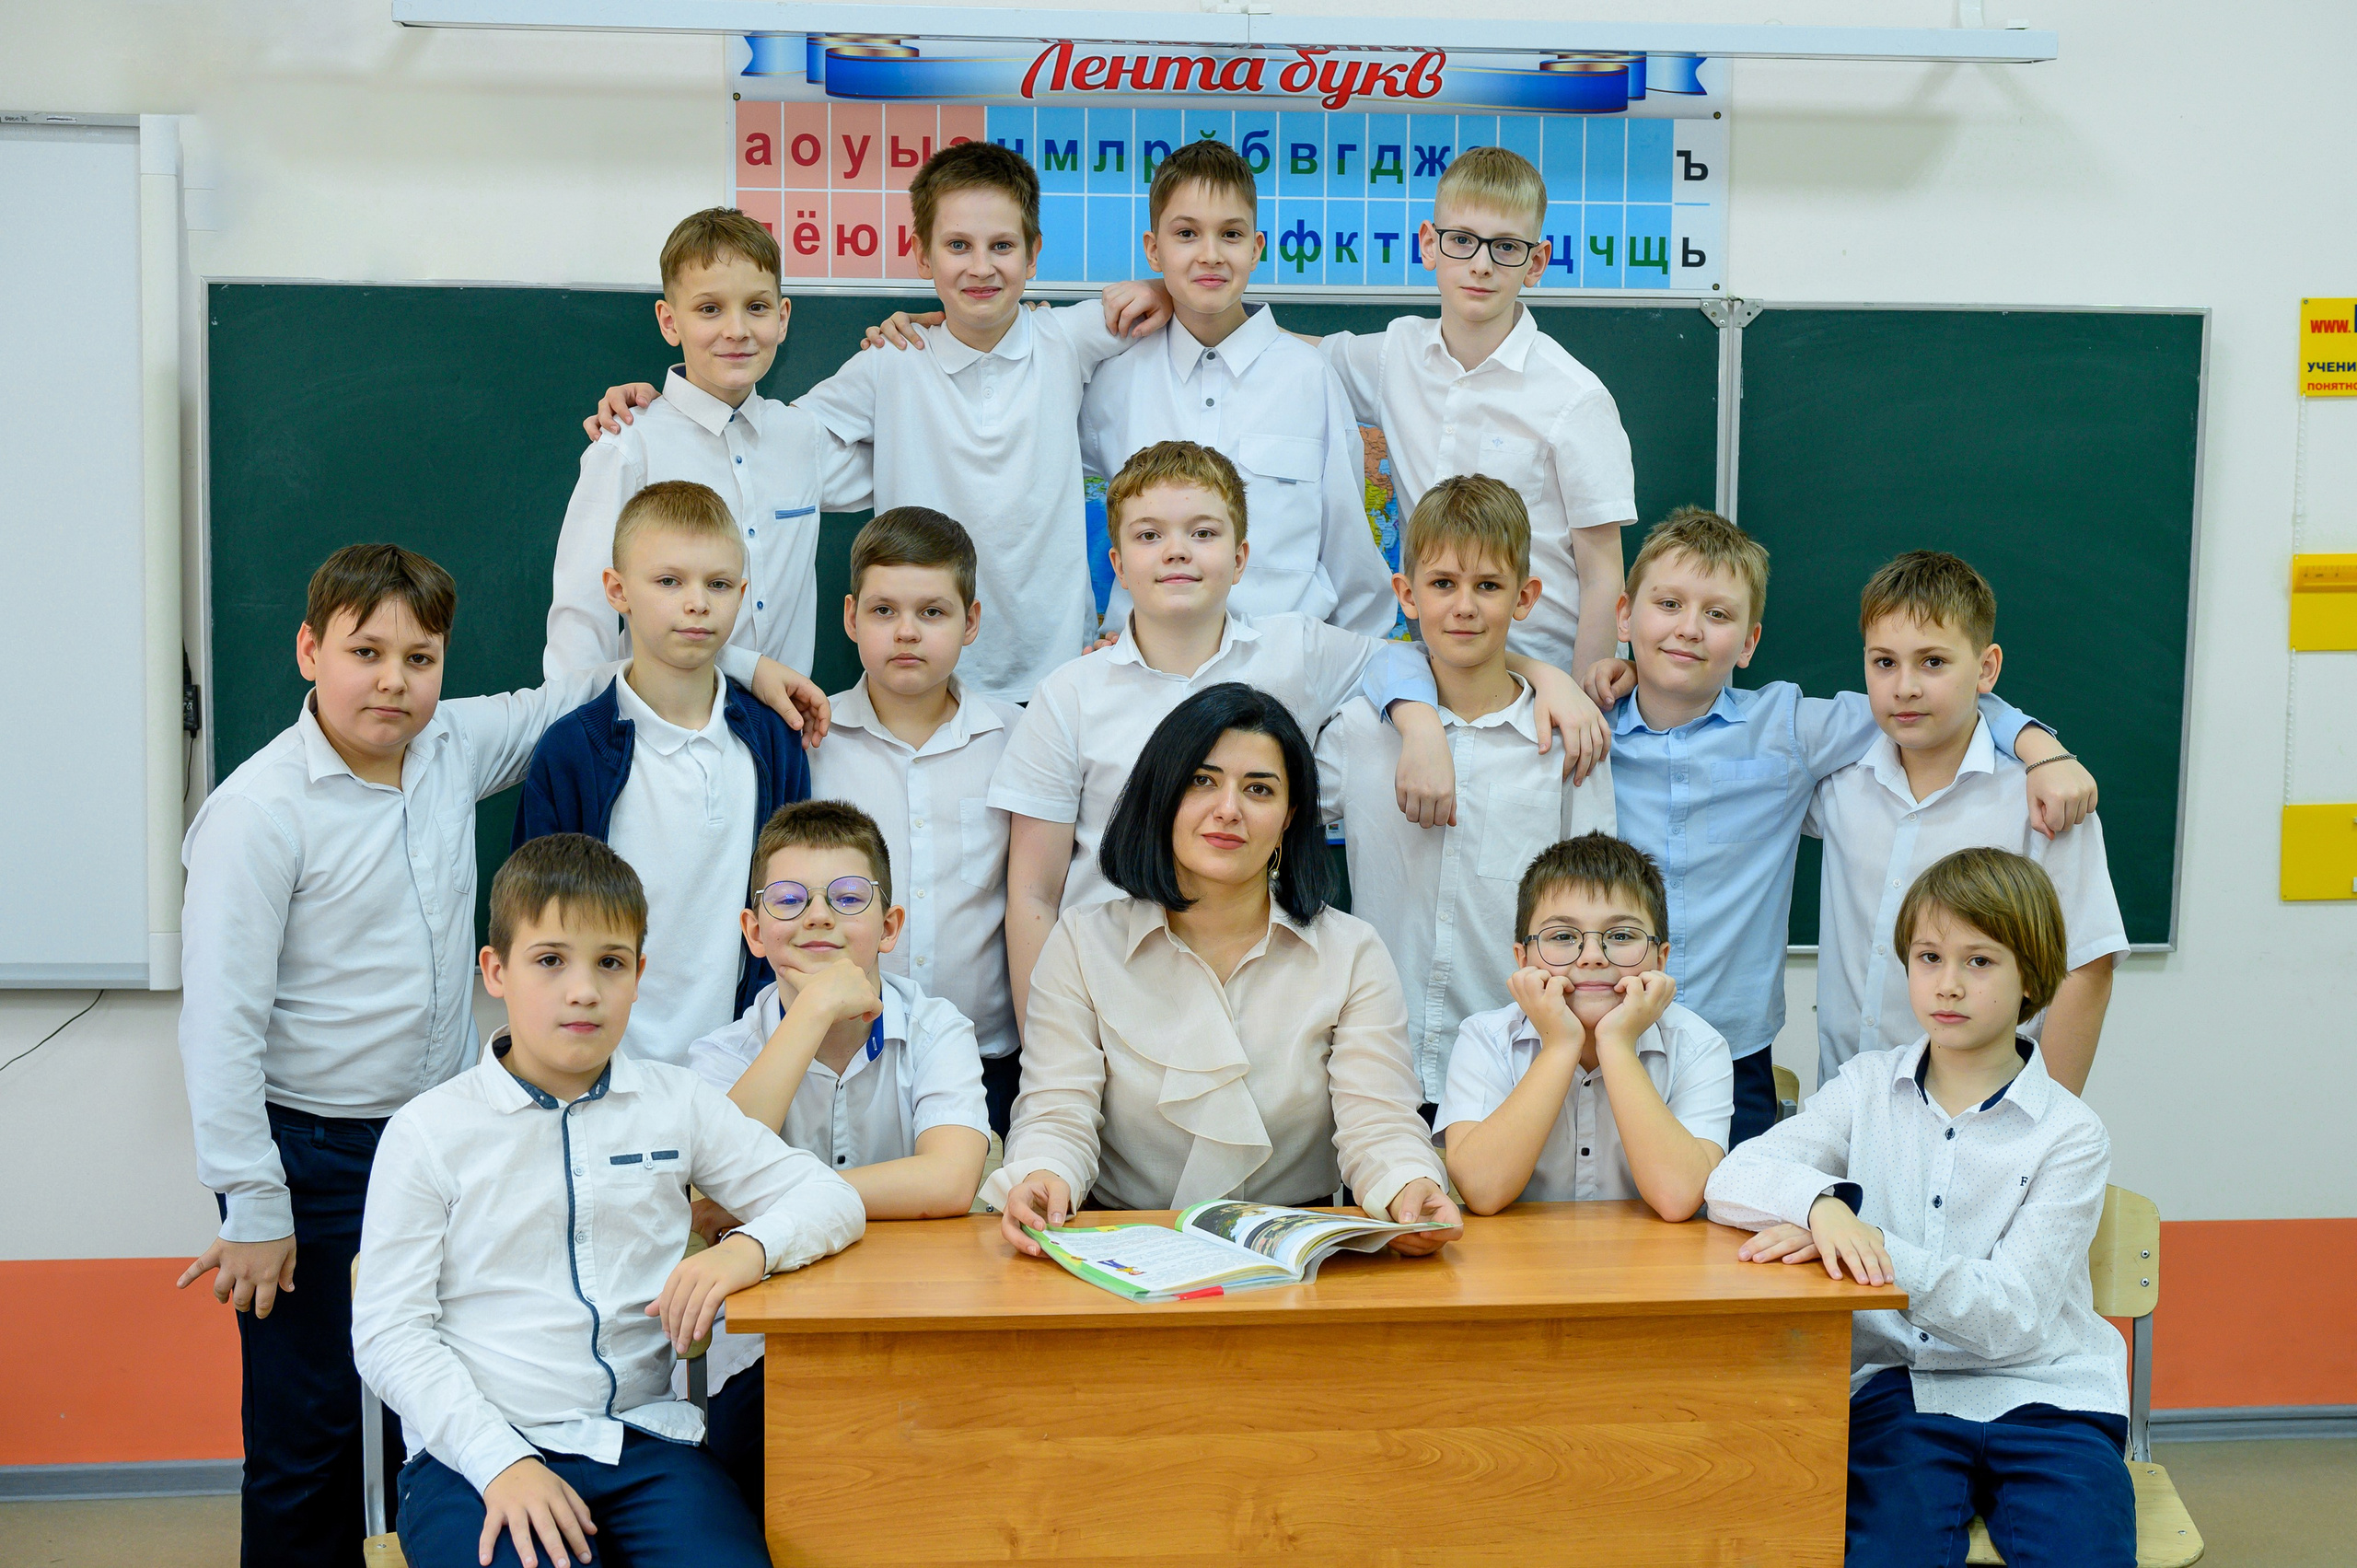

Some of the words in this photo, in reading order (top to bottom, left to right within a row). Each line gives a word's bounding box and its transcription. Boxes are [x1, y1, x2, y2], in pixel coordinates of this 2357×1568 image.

[1020, 43, 1264, 99] Лента
[1280, 50, 1446, 110] букв
[745, 133, 772, 166] а
[791, 134, 821, 167] о
[842, 134, 871, 179] у
[890, 135, 931, 168] ы
[1044, 139, 1078, 171] м
[1094, 140, 1124, 172] л
[1242, 130, 1271, 174] б
[1291, 145, 1318, 175] в
[1337, 145, 1357, 175] г
[1370, 145, 1403, 184] д
[1413, 145, 1451, 177] ж
[793, 210, 820, 255] ё
[836, 223, 878, 257] ю
[1280, 219, 1322, 273] ф
[1335, 231, 1359, 263] к
[1374, 232, 1399, 264] т
[1546, 235, 1574, 274] ц
[1589, 235, 1615, 266] ч
[1629, 236, 1668, 274] щ
